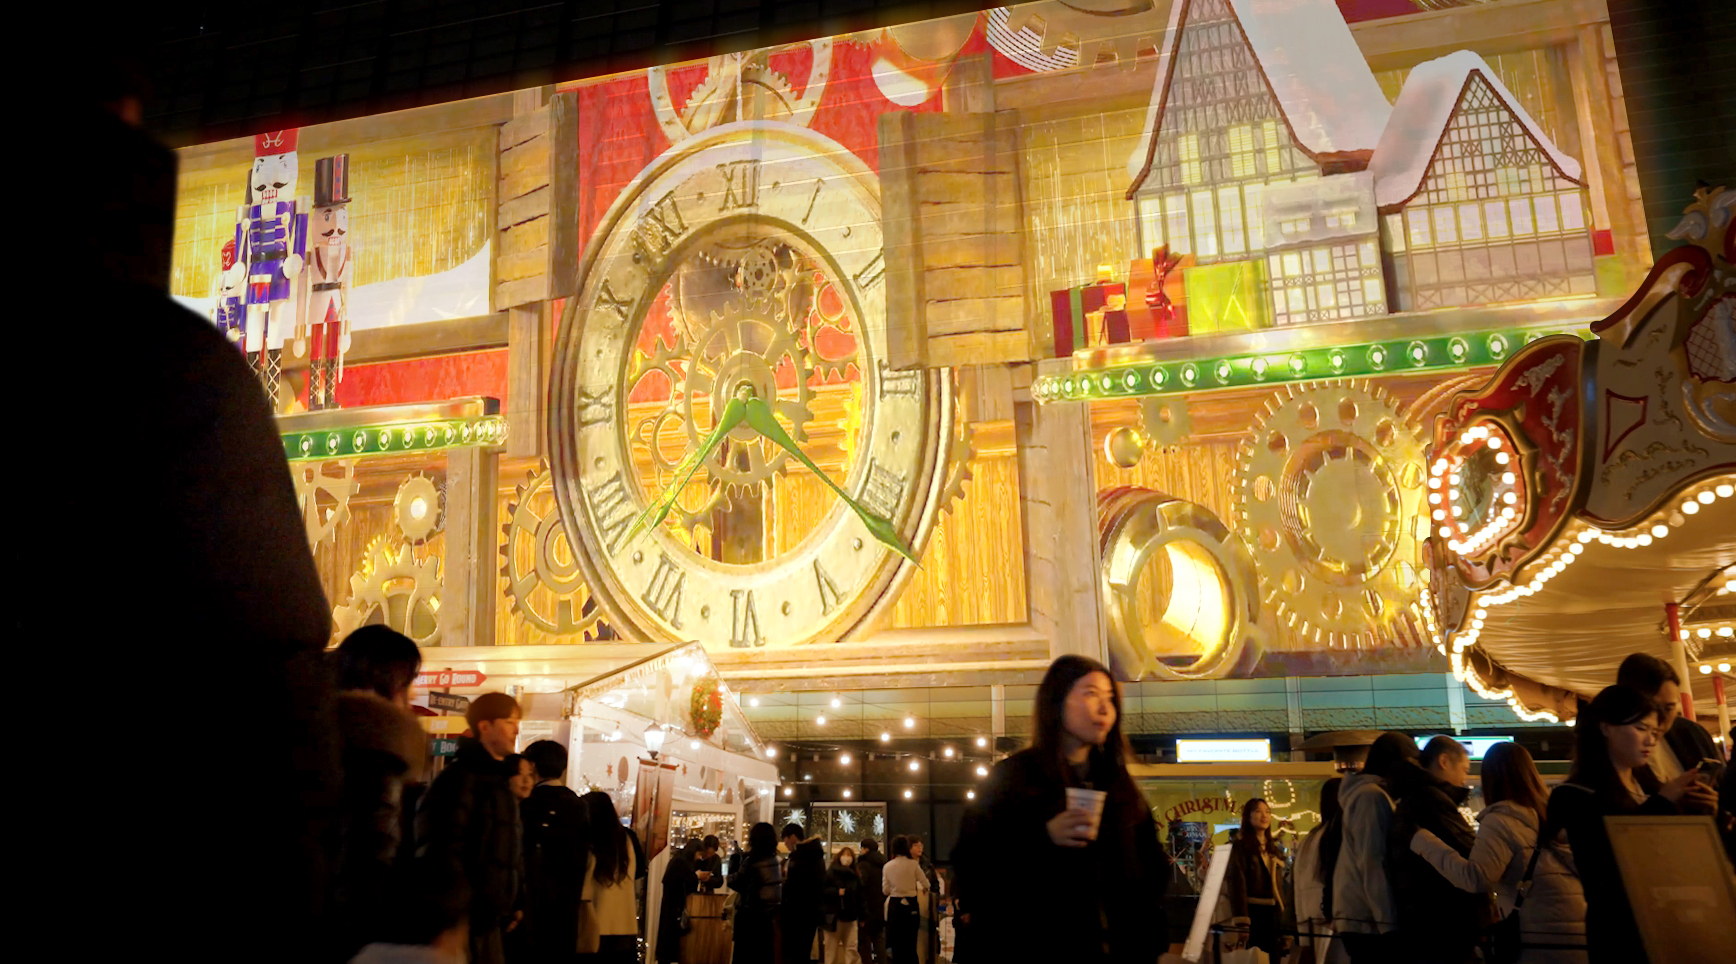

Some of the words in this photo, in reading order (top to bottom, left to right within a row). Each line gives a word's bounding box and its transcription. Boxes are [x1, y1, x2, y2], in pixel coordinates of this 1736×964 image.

[716, 158, 764, 213] XII
[729, 589, 766, 648] VI
[1165, 796, 1244, 822] CHRISTMA
